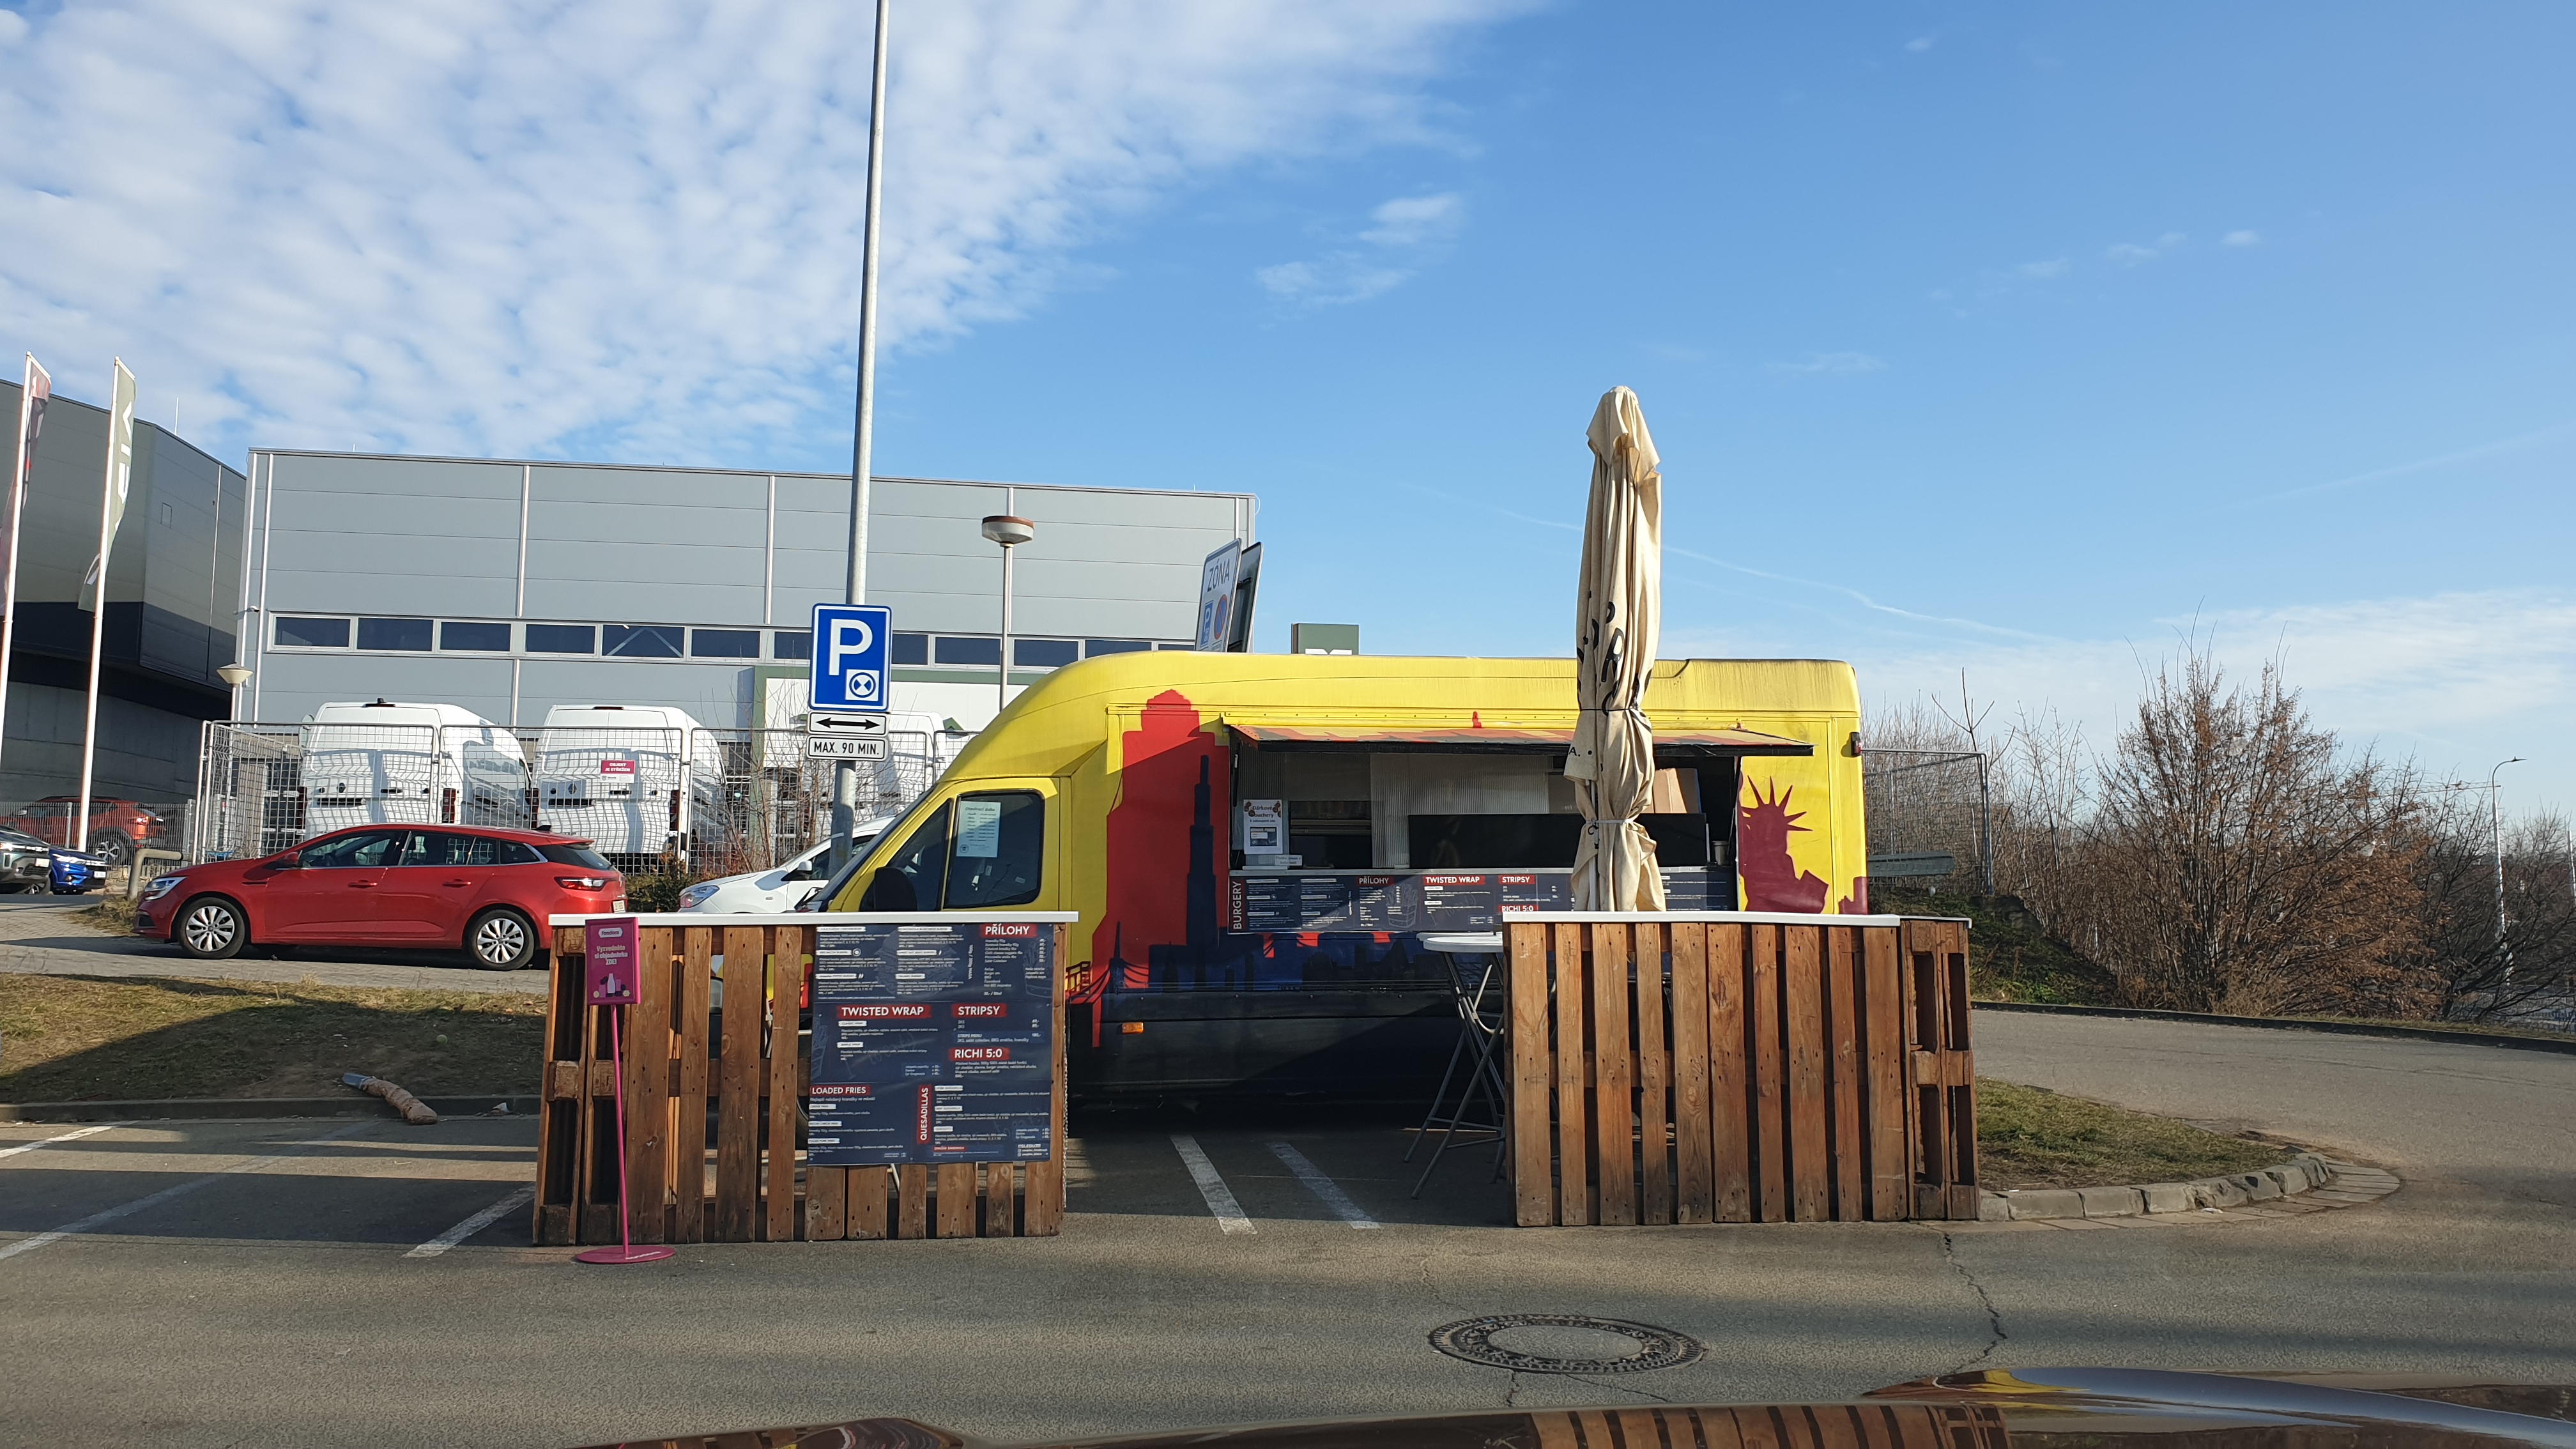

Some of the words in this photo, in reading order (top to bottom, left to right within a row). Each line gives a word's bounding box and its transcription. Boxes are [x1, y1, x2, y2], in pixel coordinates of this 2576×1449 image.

[1207, 558, 1230, 592] ZÓNA
[829, 618, 873, 675] P
[814, 742, 838, 754] MAX.
[842, 742, 854, 754] 90
[858, 743, 879, 755] MIN.
[1359, 876, 1389, 884] PŘÍLOHY
[1232, 881, 1242, 930] BURGERY
[985, 923, 1030, 935] PŘÍLOHY
[841, 1007, 889, 1016] TWISTED
[892, 1006, 924, 1016] WRAP
[958, 1006, 1000, 1015] STRIPSY
[954, 1049, 983, 1059] RICHI
[986, 1048, 1002, 1058] 5:0
[920, 1087, 928, 1140] QUESADILLAS
